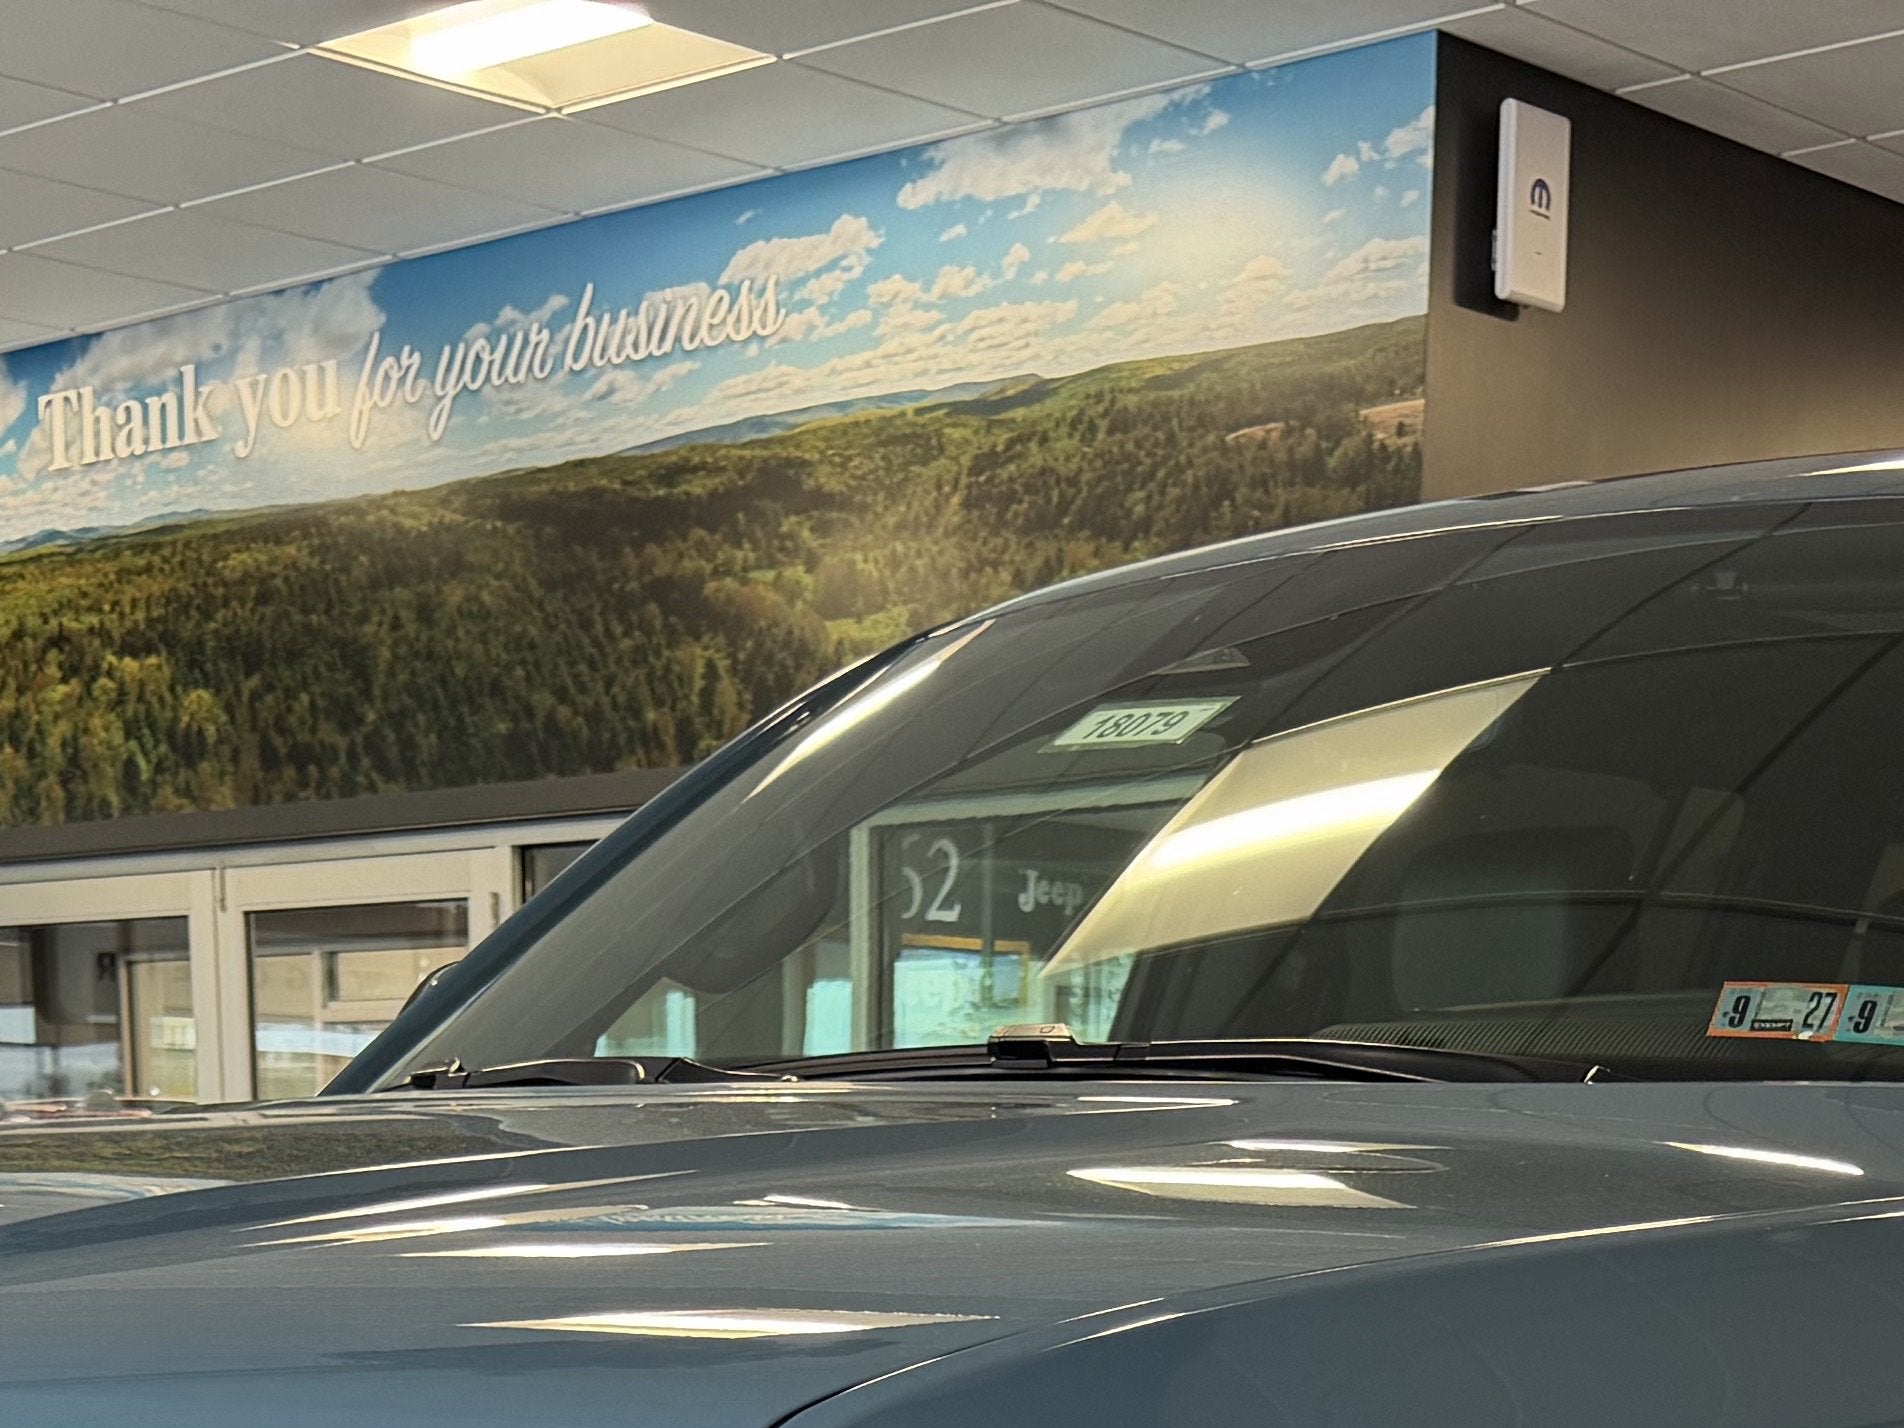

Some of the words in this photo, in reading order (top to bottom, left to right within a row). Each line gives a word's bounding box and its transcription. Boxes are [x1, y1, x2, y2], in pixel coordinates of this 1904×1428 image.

[37, 365, 221, 471] Thank
[234, 358, 341, 458] you
[351, 330, 426, 450] for
[431, 328, 553, 443] your
[562, 275, 786, 374] business
[1081, 709, 1191, 741] 18079
[1801, 991, 1838, 1032] 27
